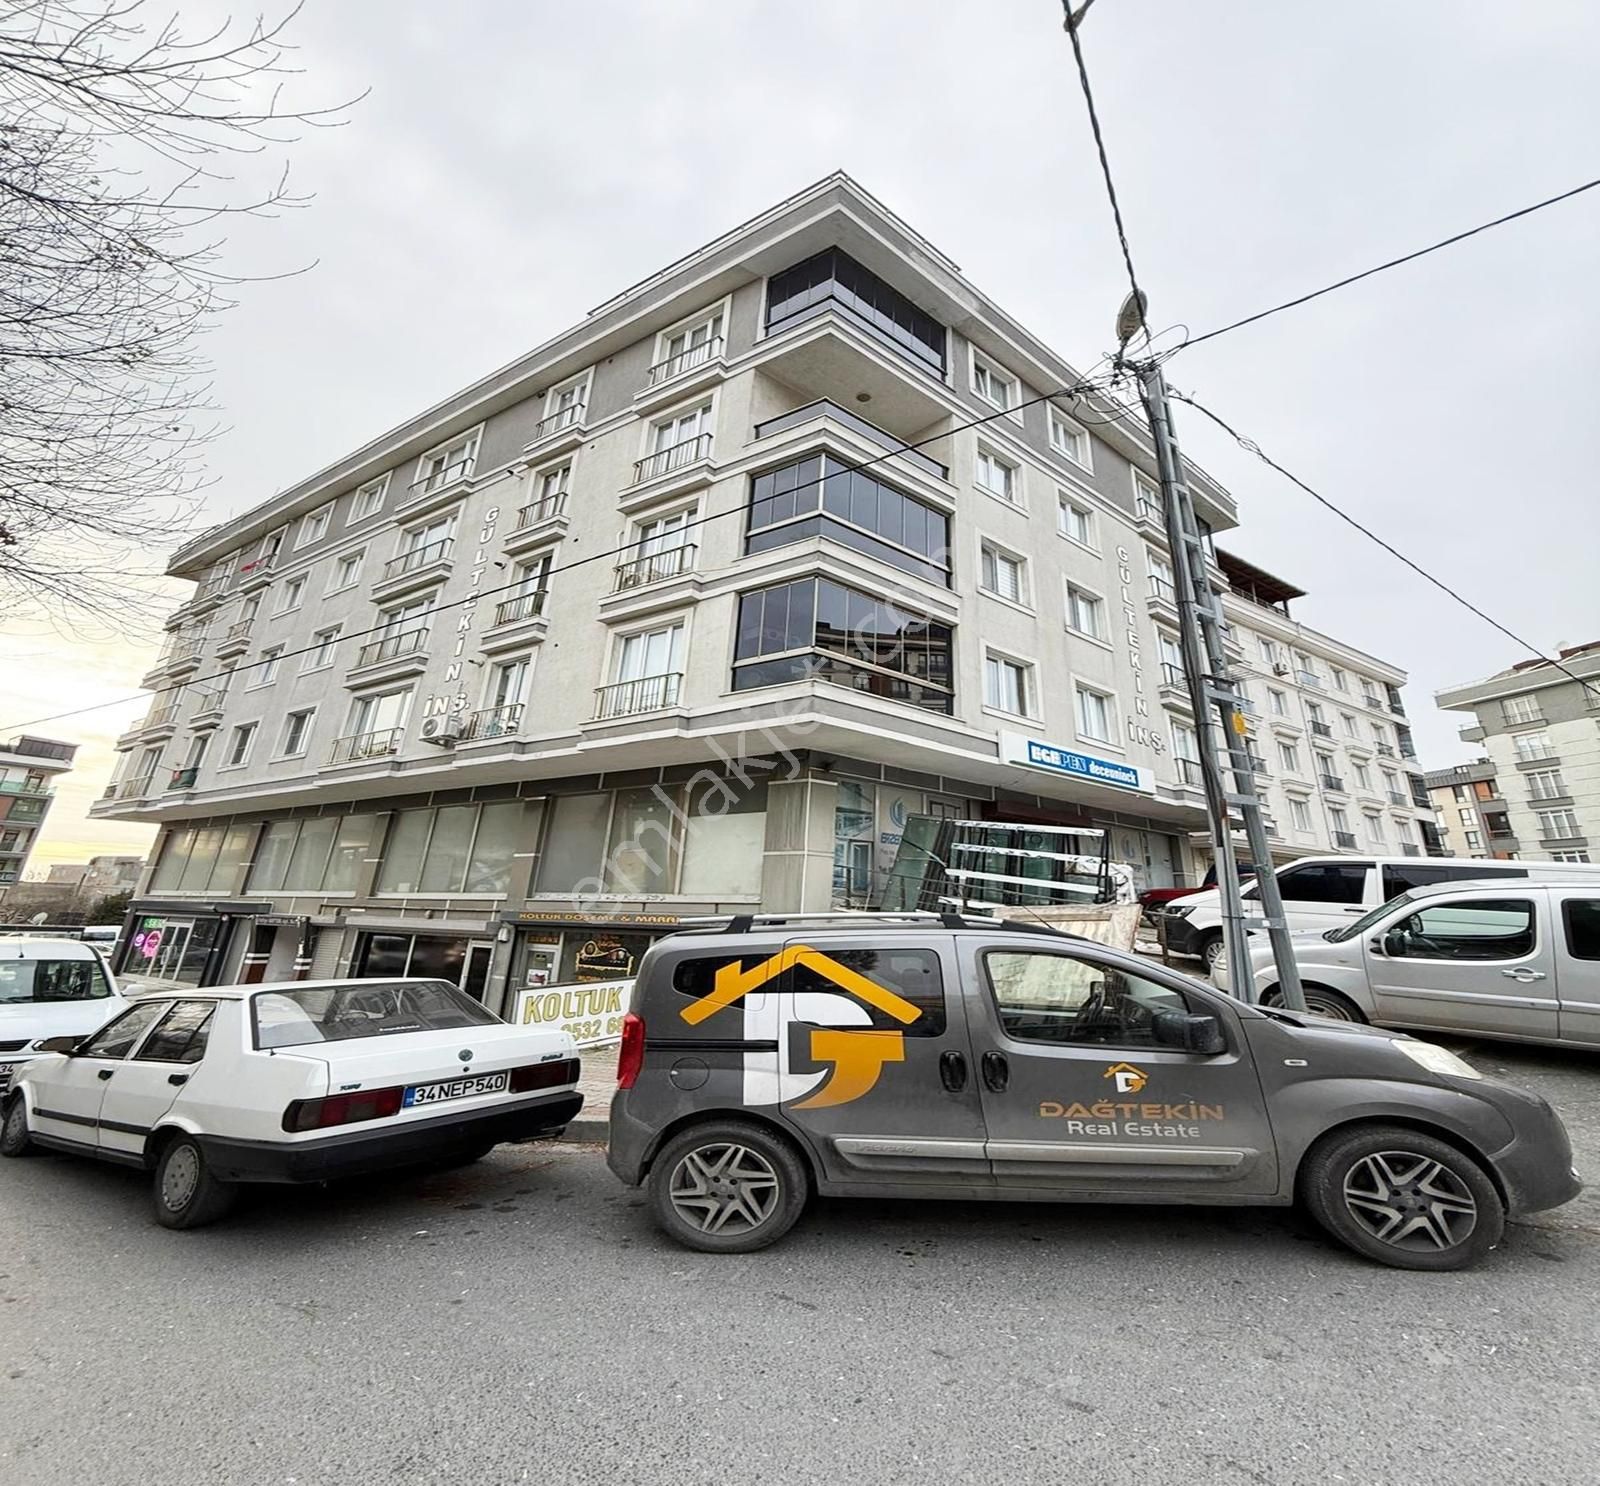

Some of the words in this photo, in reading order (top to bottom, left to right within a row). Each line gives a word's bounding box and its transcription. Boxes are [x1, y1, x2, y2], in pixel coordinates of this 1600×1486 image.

[519, 912, 561, 920] KOLTUK
[523, 986, 624, 1025] KOLTUK
[1039, 1099, 1225, 1121] DAĞTEKİN
[1067, 1120, 1118, 1136] Real
[1124, 1122, 1201, 1138] Estate
